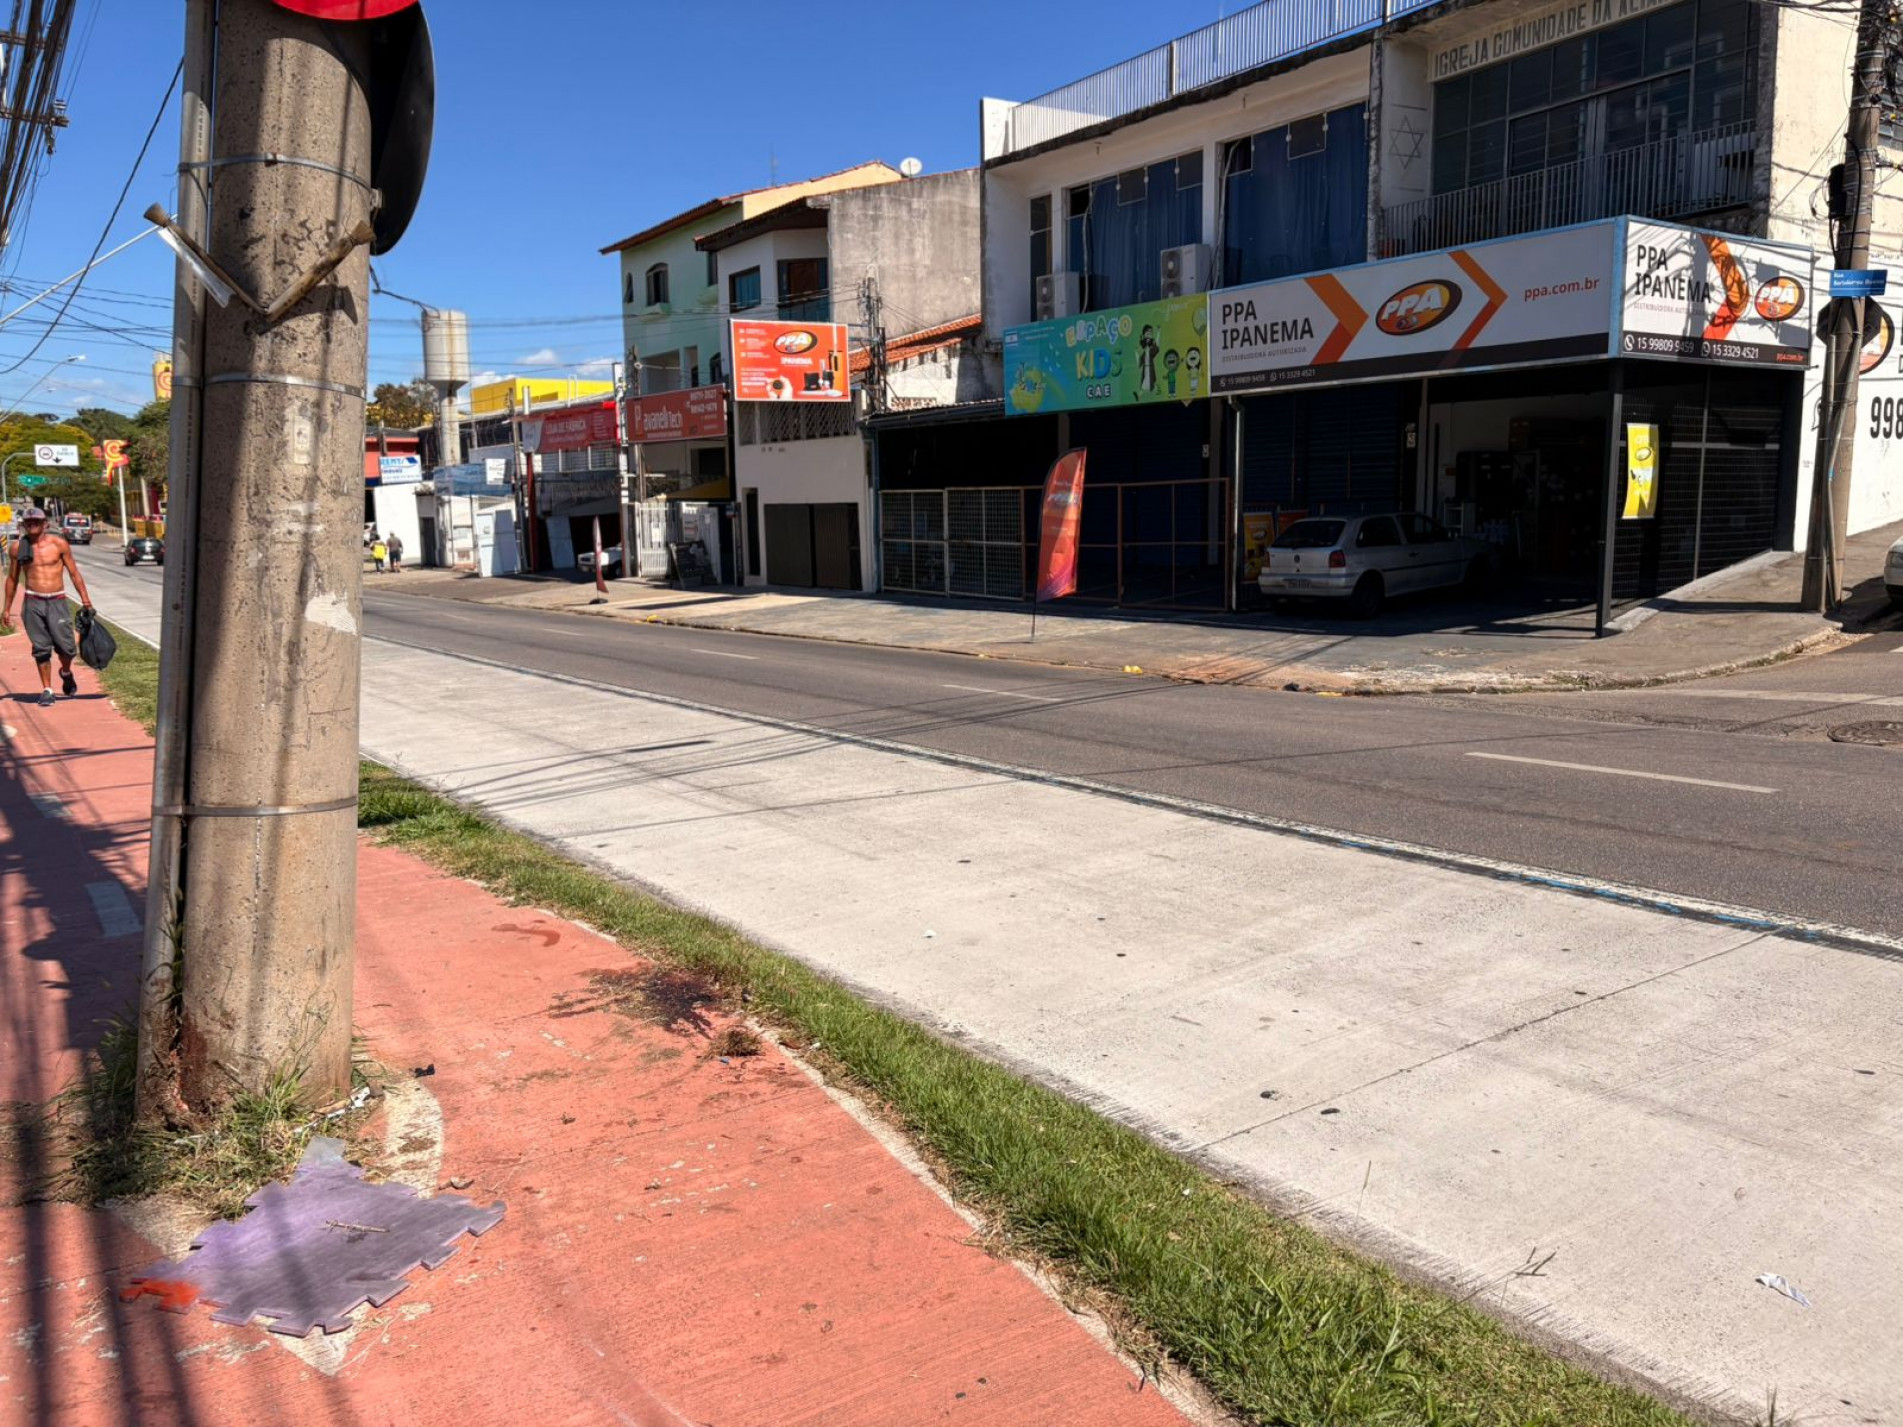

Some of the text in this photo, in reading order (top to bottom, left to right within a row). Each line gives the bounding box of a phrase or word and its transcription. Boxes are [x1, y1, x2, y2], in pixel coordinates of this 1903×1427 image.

[1434, 38, 1489, 78] IGREJA
[1592, 0, 1611, 25] DA
[1637, 245, 1668, 271] PPA
[1524, 277, 1600, 302] ppa.com.br
[1634, 272, 1711, 303] IPANEMA
[1757, 285, 1795, 304] PPA
[1222, 300, 1257, 325] PPA
[1381, 285, 1443, 321] PPA
[775, 331, 811, 346] PPA
[1222, 317, 1314, 350] IPANEMA
[1637, 337, 1647, 350] 15
[1648, 338, 1674, 351] 99809
[1713, 344, 1722, 355] 15
[1724, 345, 1741, 358] 3329
[1742, 347, 1759, 359] 4521
[1075, 347, 1123, 380] KIDS
